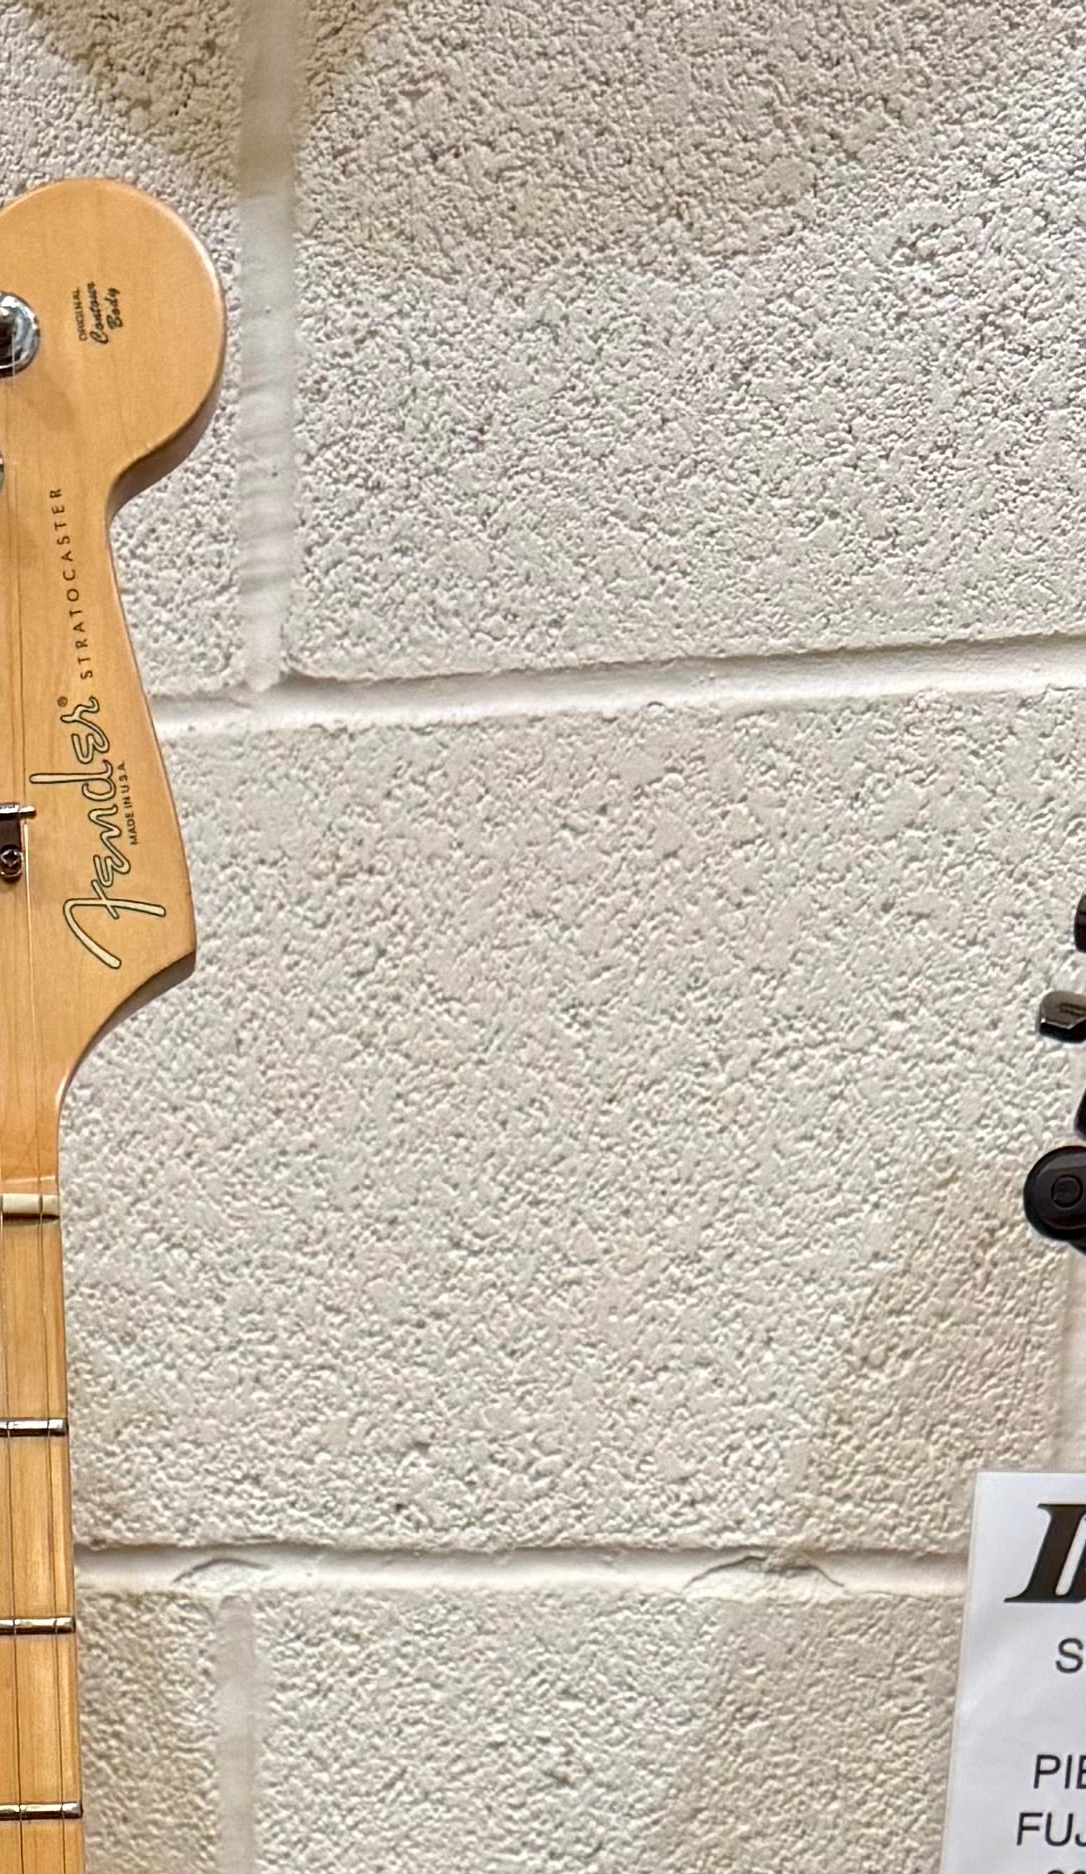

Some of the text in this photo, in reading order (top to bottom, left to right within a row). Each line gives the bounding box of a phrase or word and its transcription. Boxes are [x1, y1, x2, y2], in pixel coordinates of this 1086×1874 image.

[104, 287, 123, 330] Body
[49, 486, 94, 680] STRATOCASTER
[122, 796, 133, 808] IN
[125, 811, 139, 846] MADE
